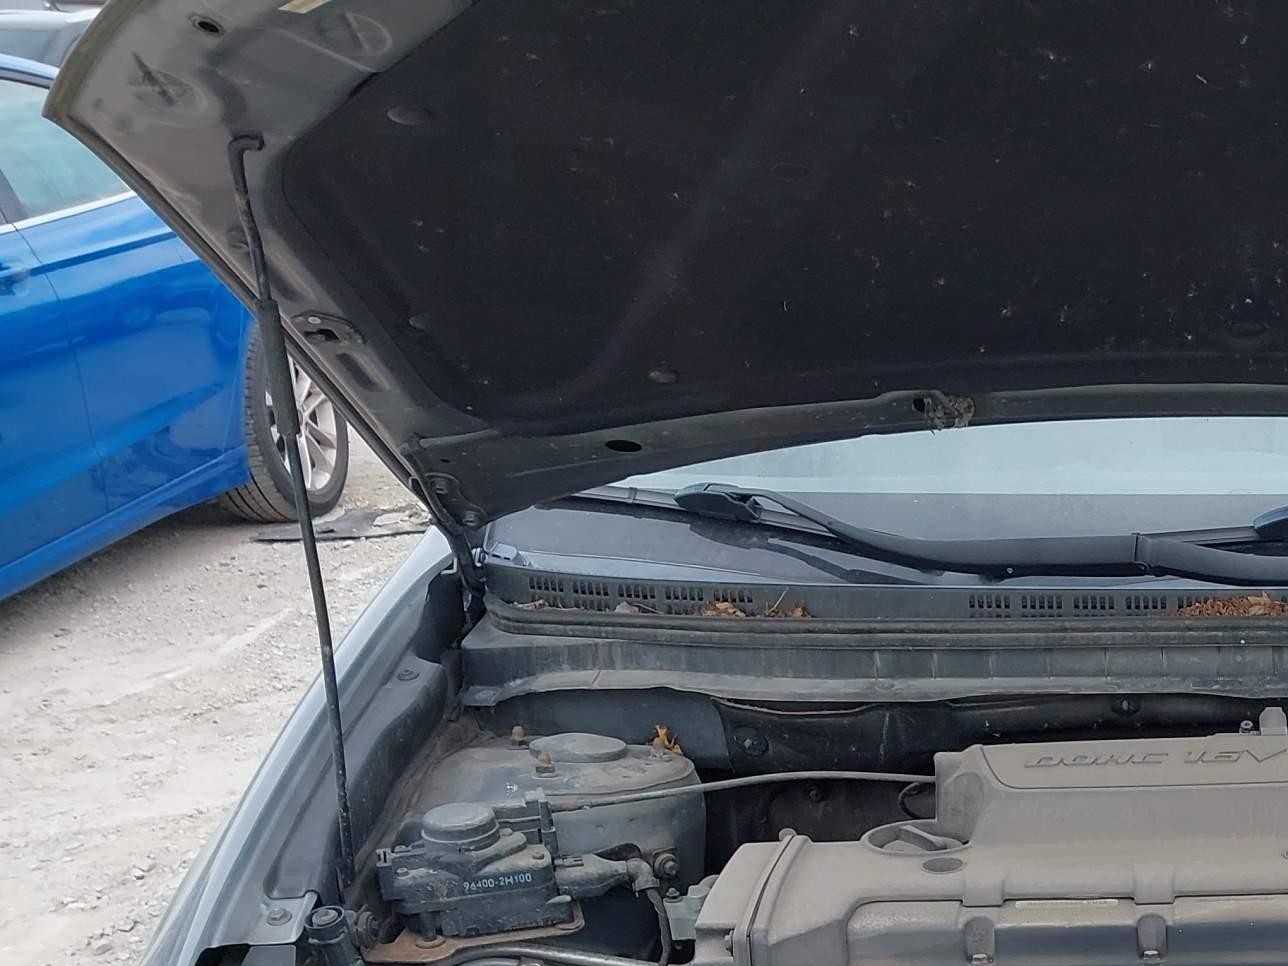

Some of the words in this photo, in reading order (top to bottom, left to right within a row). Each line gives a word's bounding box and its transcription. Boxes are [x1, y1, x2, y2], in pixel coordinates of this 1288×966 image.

[1024, 754, 1168, 768] DOHC
[1184, 749, 1287, 764] 16V
[463, 873, 532, 894] 96400-2H100
